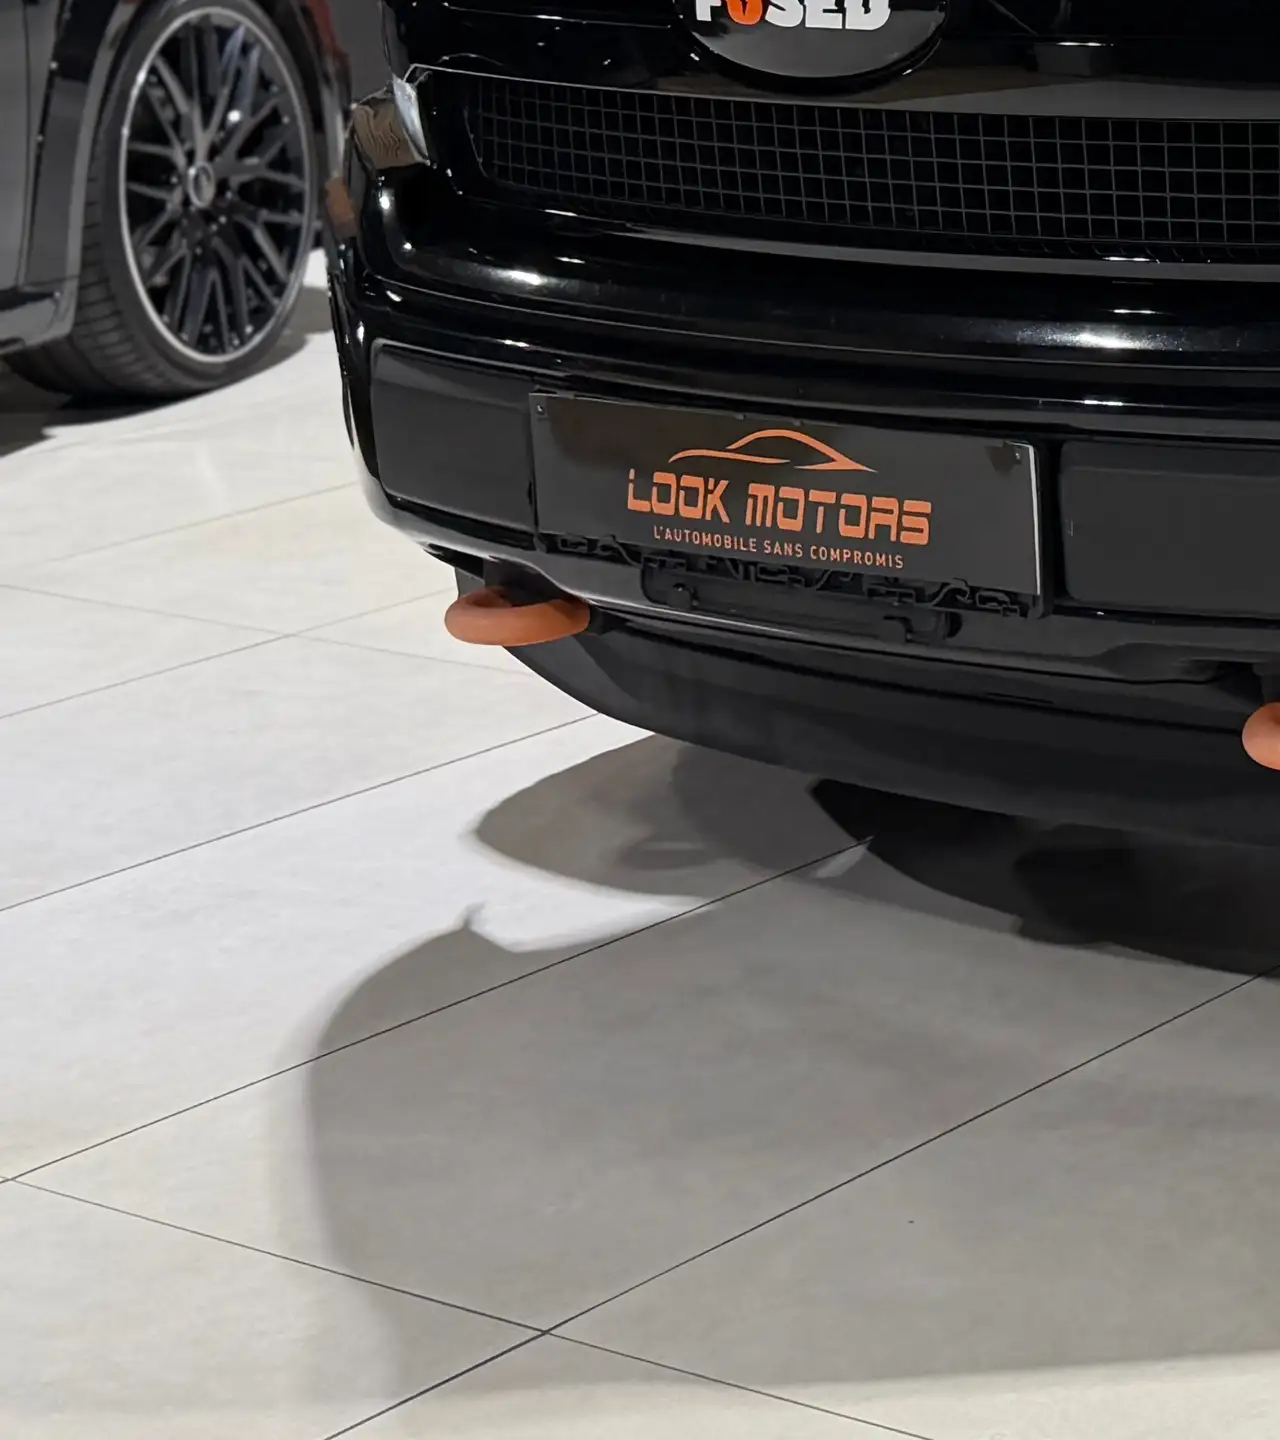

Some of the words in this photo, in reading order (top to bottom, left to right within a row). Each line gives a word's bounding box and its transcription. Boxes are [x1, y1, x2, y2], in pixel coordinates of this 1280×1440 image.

[627, 468, 730, 524] LOOK
[745, 482, 932, 546] MOTORS
[653, 525, 757, 553] L'AUTOMOBILE
[763, 540, 803, 558] SANS
[810, 545, 904, 569] COMPROMIS
